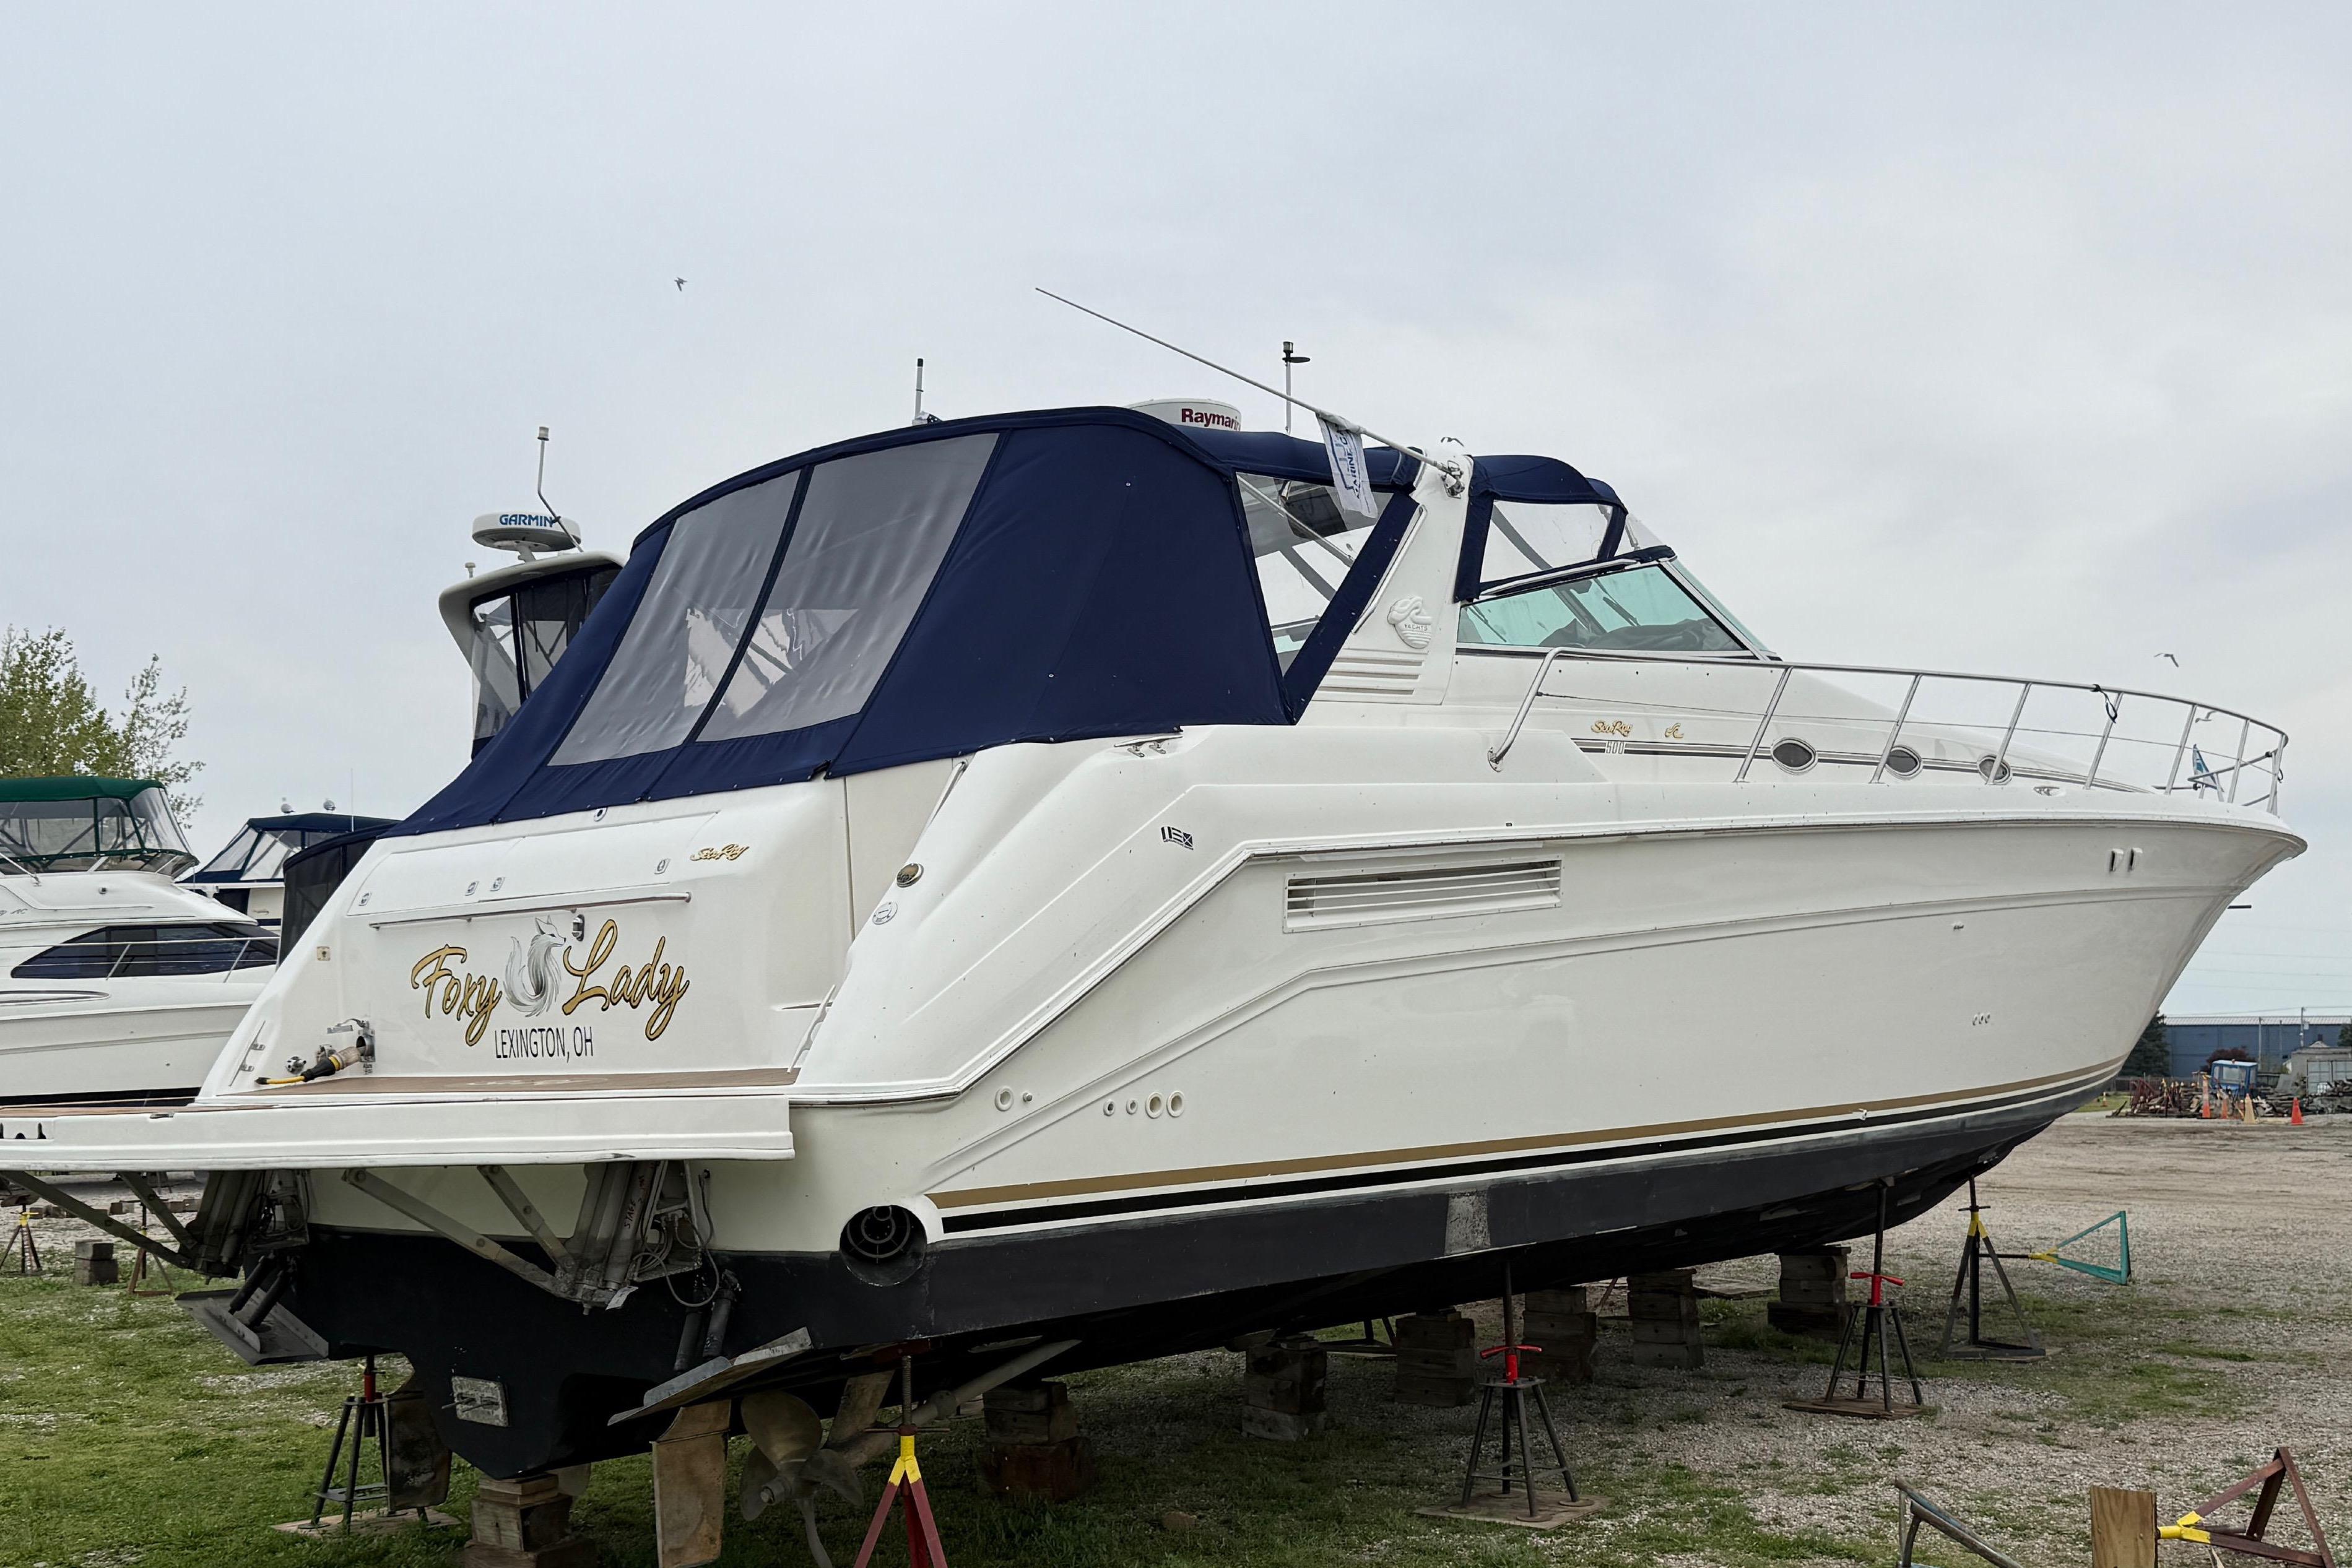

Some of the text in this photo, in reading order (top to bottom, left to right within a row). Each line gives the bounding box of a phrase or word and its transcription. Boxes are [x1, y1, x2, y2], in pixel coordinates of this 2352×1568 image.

[499, 514, 553, 527] GARMIN
[1404, 623, 1428, 631] YACHTS
[1605, 741, 1626, 754] 500
[410, 918, 690, 1047] Foxy Lady
[494, 1026, 594, 1063] LEXINGTON, OH
